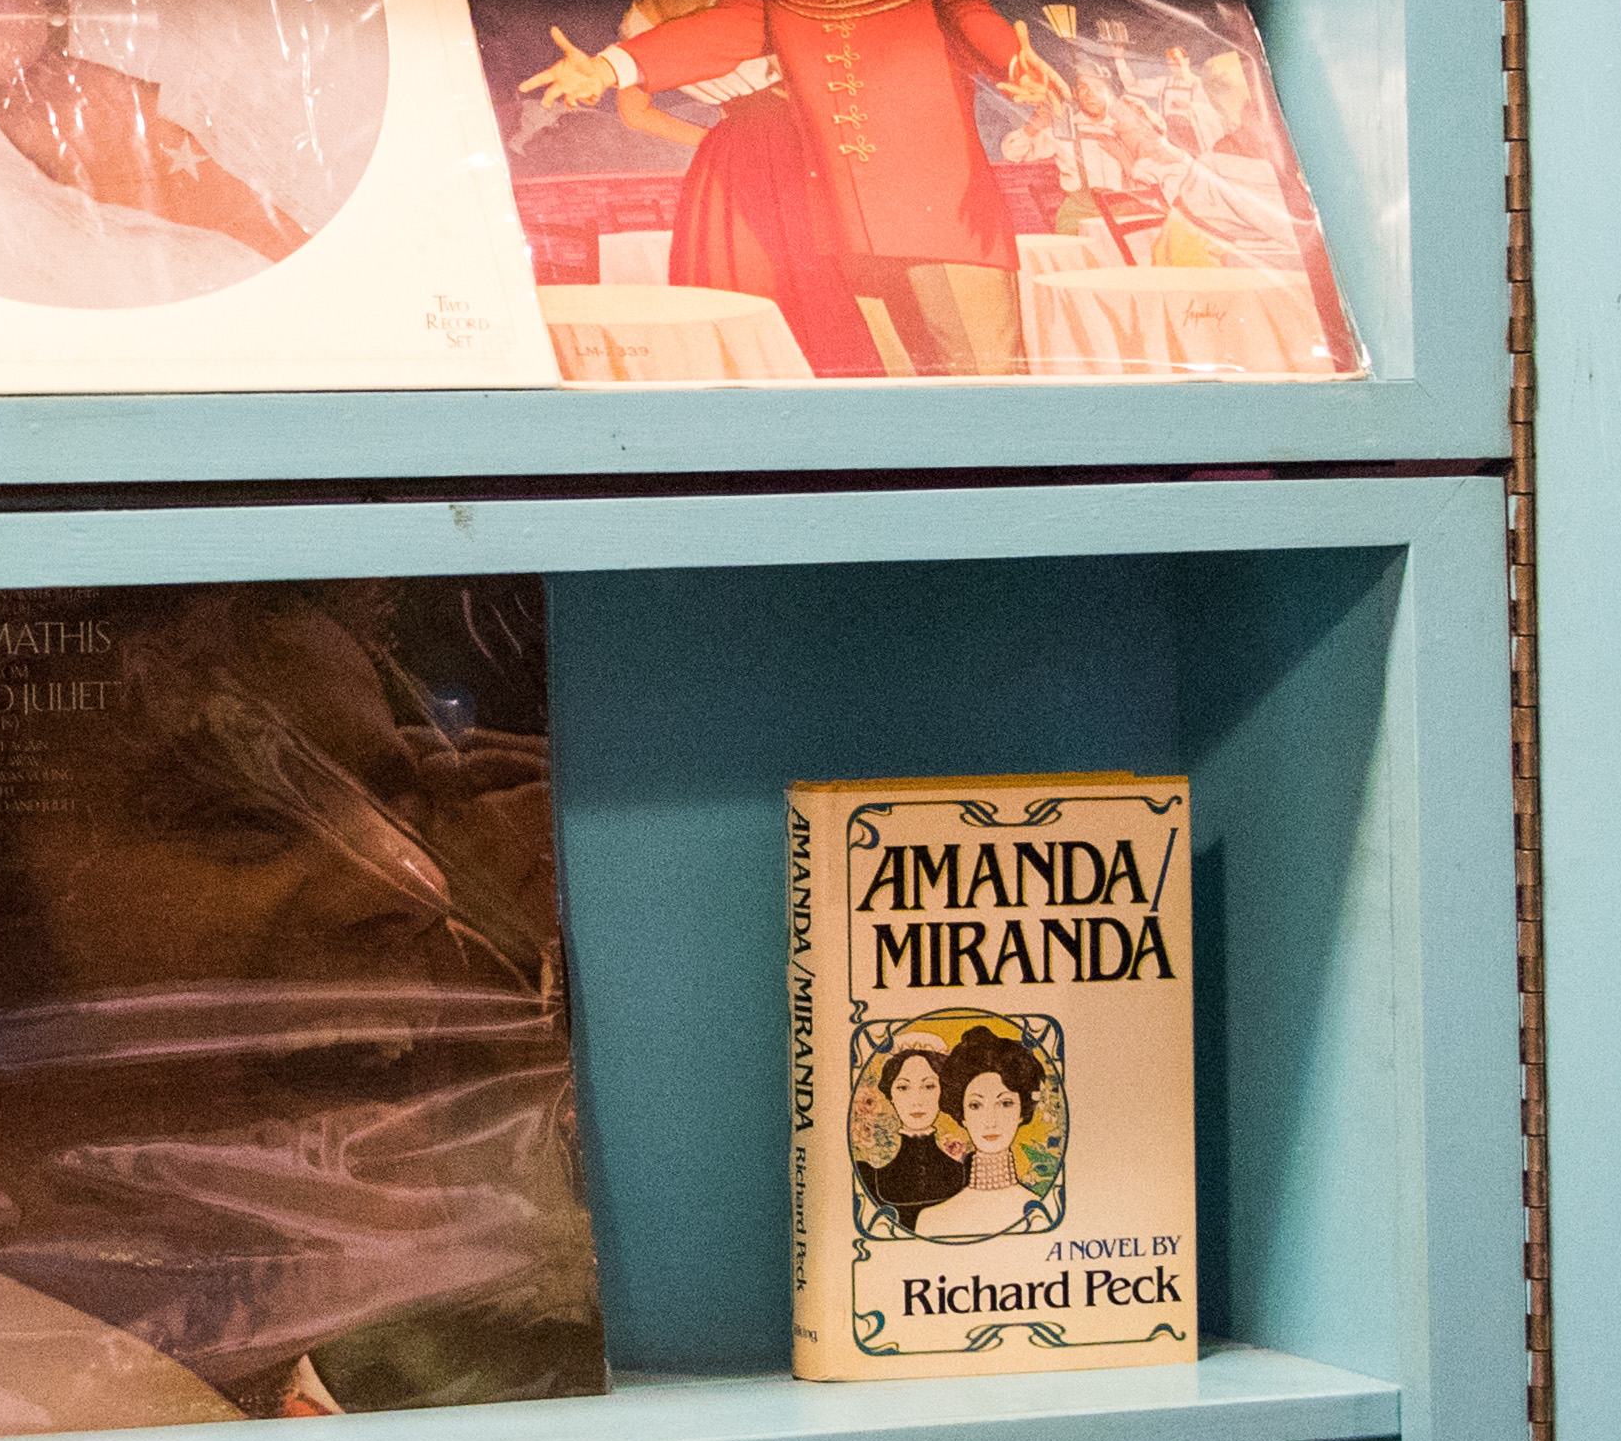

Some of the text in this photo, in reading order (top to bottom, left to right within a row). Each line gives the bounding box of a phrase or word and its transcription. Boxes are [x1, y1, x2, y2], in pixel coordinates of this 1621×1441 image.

[872, 913, 1175, 990] MIRANDA
[1045, 1234, 1181, 1262] A NOVEL BY
[901, 1266, 1182, 1318] Richard Peck
